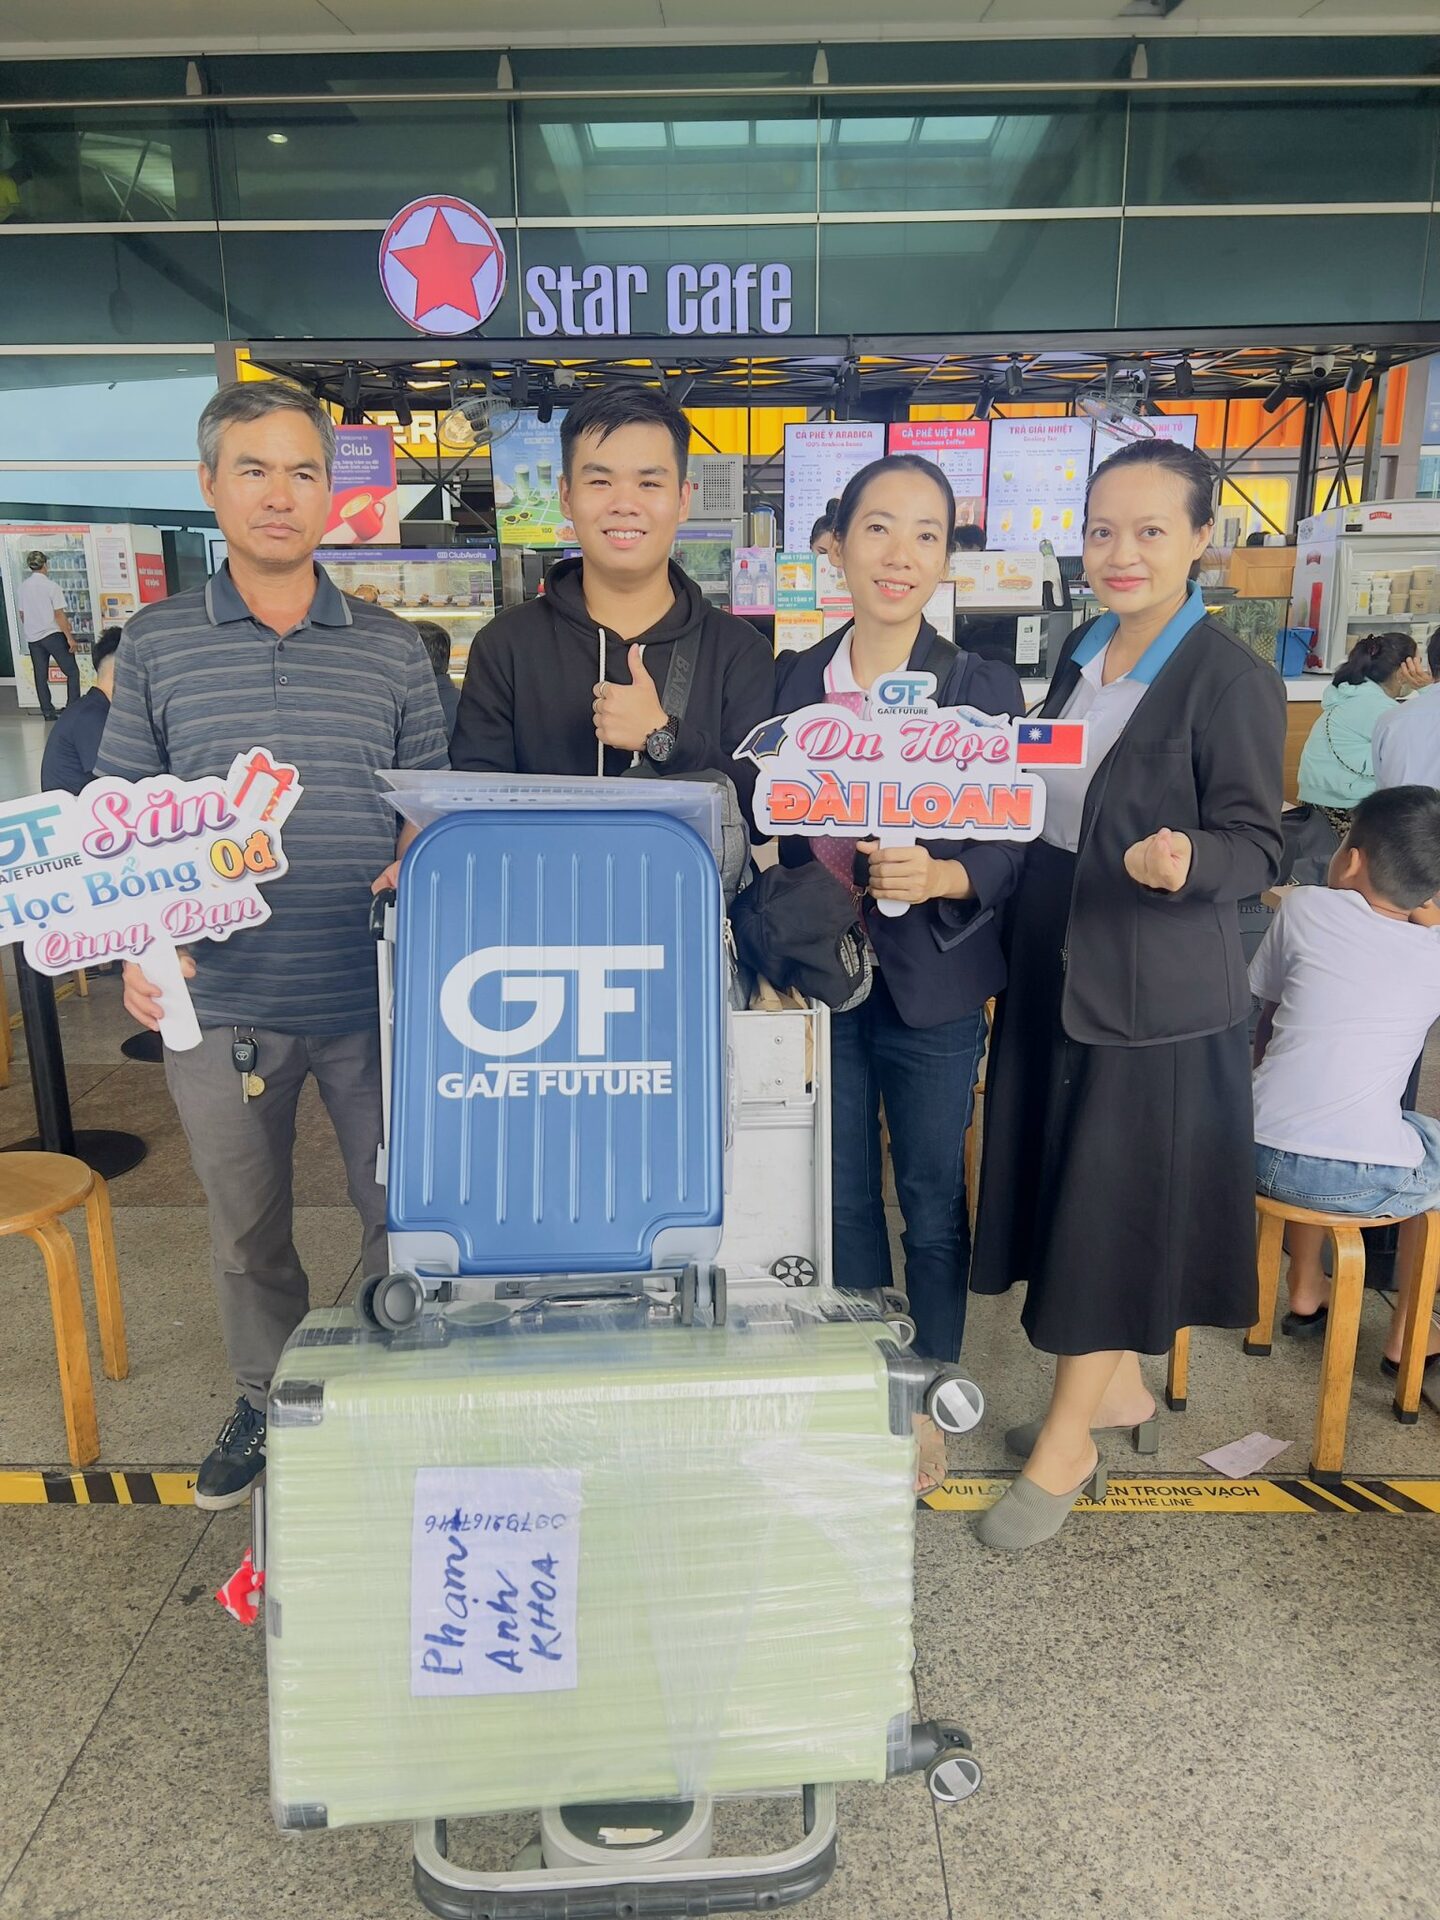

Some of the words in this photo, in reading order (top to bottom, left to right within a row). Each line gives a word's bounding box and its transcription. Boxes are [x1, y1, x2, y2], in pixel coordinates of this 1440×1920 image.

[836, 430, 873, 439] ARABICA
[956, 427, 976, 437] NAM
[340, 443, 373, 456] Club
[879, 680, 928, 705] GF
[877, 707, 897, 715] GATE
[796, 717, 884, 763] Du
[899, 717, 1011, 772] Học
[766, 769, 870, 828] ĐÀI
[878, 783, 1034, 830] LOAN
[82, 790, 239, 859] Săn
[25, 854, 83, 877] FUTURE
[82, 856, 201, 907] Bổng
[35, 923, 155, 968] Cùng
[161, 895, 262, 938] Bạn
[440, 944, 664, 1056] GF
[437, 1064, 529, 1098] GATE
[538, 1068, 672, 1096] FUTURE
[942, 1485, 973, 1495] VUI
[1130, 1486, 1202, 1497] TRONG
[1204, 1486, 1260, 1499] VẠCH
[1074, 1498, 1108, 1507] STAY
[1111, 1498, 1126, 1507] IN
[1127, 1498, 1159, 1507] THE
[1160, 1498, 1195, 1507] LINE
[485, 1569, 524, 1674] Anh
[526, 1552, 563, 1661] KHOA
